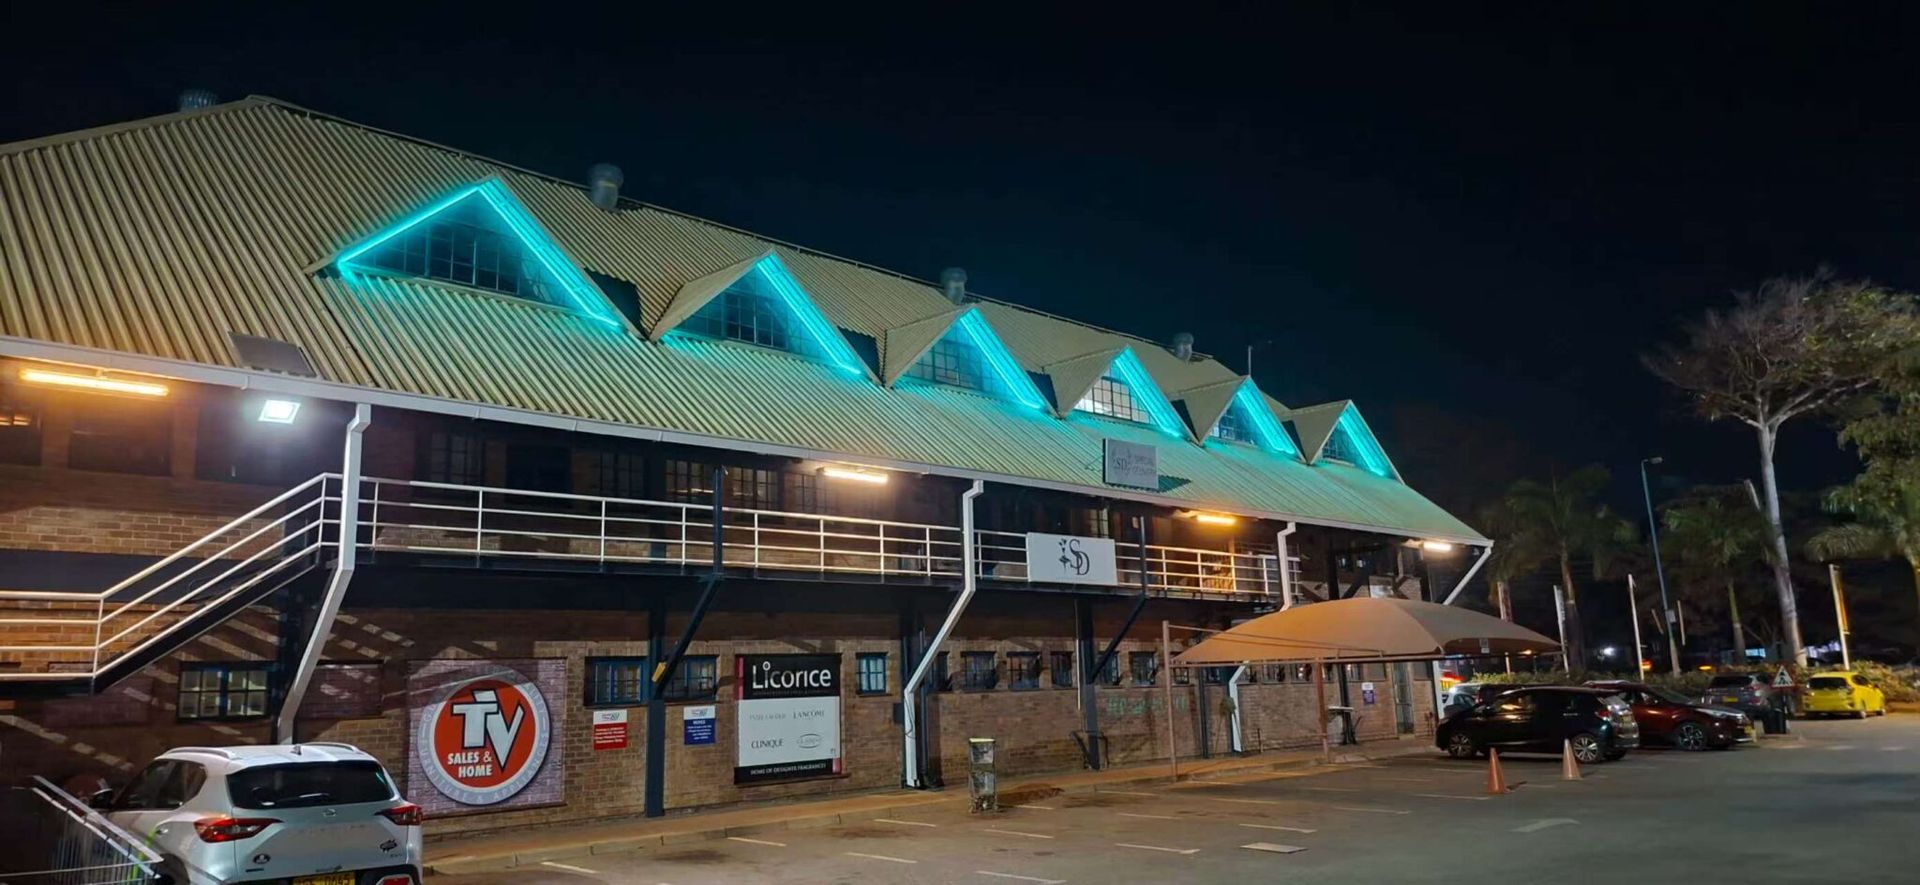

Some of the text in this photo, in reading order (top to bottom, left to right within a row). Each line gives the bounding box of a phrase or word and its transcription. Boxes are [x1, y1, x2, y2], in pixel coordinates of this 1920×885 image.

[1069, 538, 1089, 575] SD
[752, 661, 831, 689] Licorice
[452, 690, 524, 769] TV
[447, 751, 492, 765] SALES &
[458, 764, 492, 778] HOME
